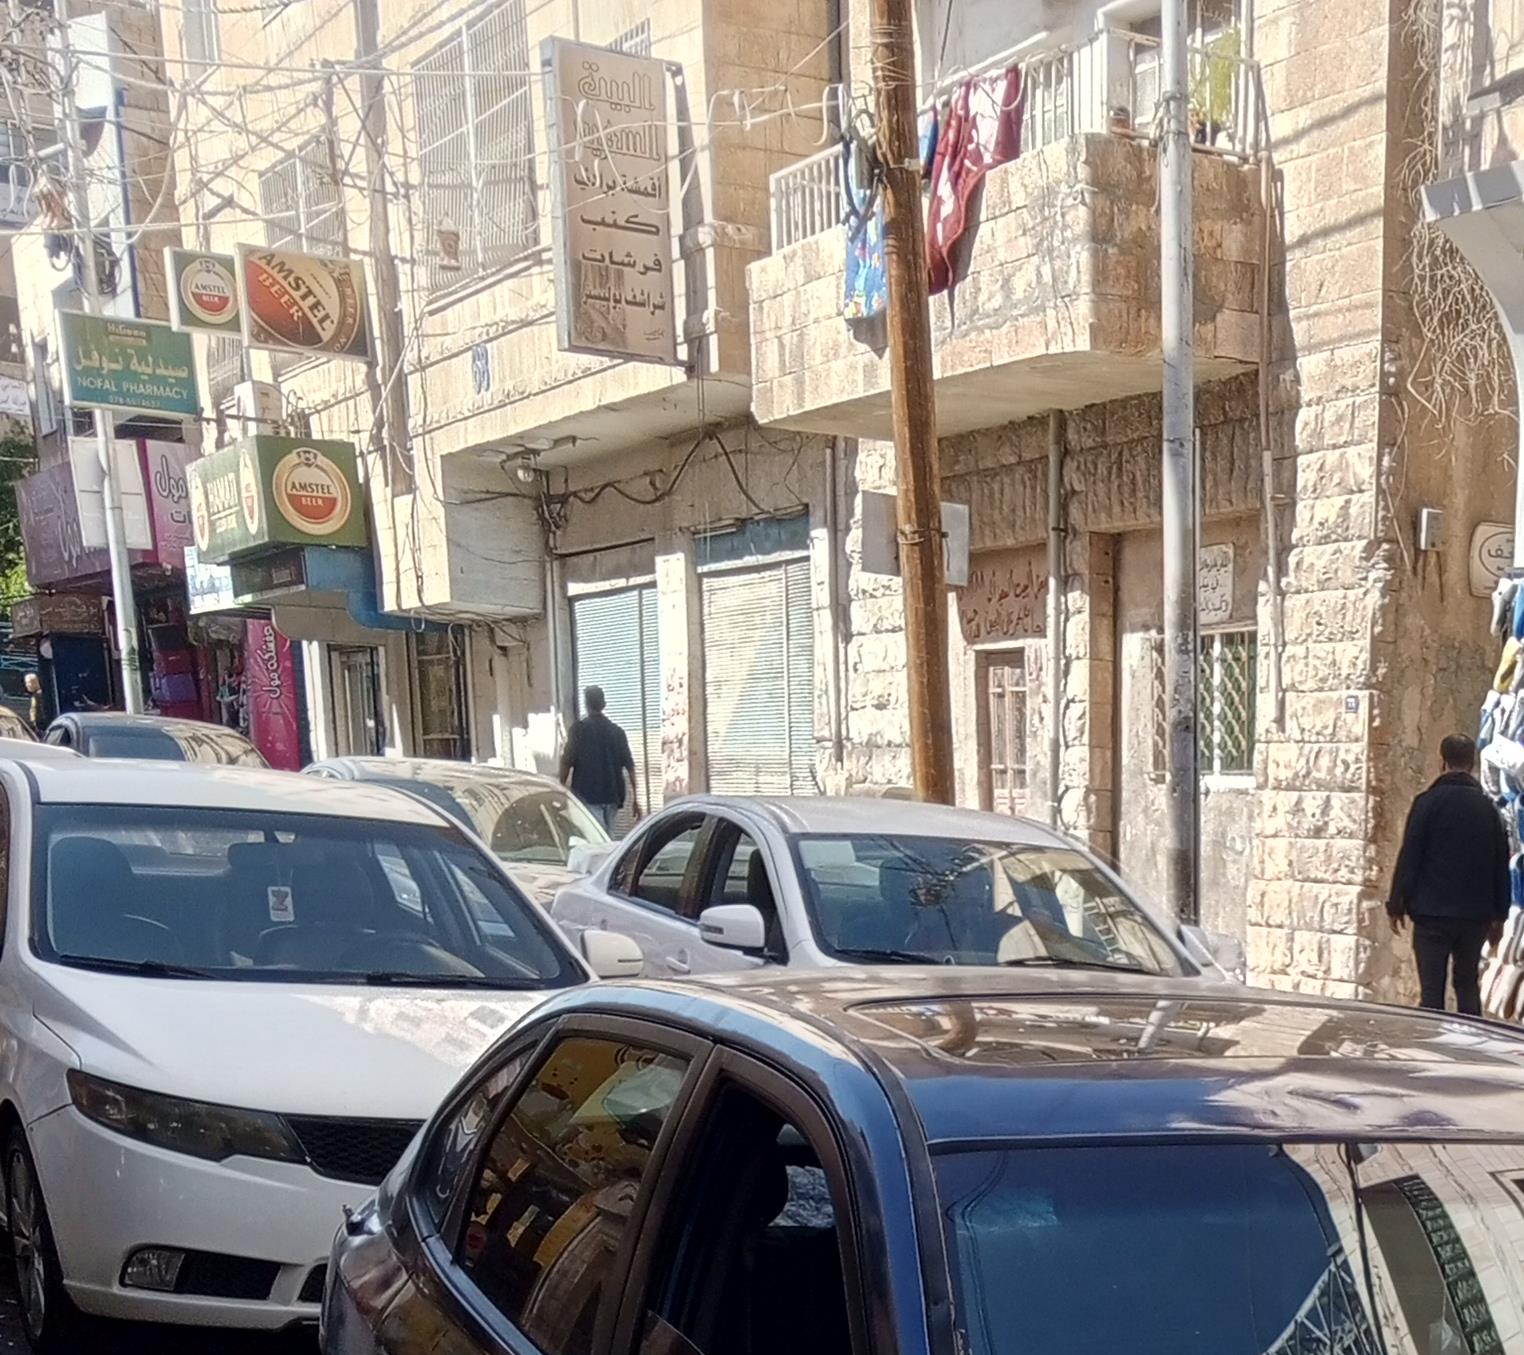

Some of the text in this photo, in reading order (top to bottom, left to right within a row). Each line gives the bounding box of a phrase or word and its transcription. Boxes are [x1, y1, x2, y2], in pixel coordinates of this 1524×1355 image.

[580, 210, 660, 236] كنب
[582, 249, 662, 275] فرشات
[194, 283, 226, 294] AMSTEL
[259, 253, 329, 332] AMSTEL
[259, 273, 302, 321] BEER
[130, 348, 189, 383] صيدلية
[78, 377, 189, 399] NOFAL PHARMACY
[290, 482, 333, 495] AMSTEL
[301, 497, 324, 506] BEER
[262, 672, 281, 698] مول
